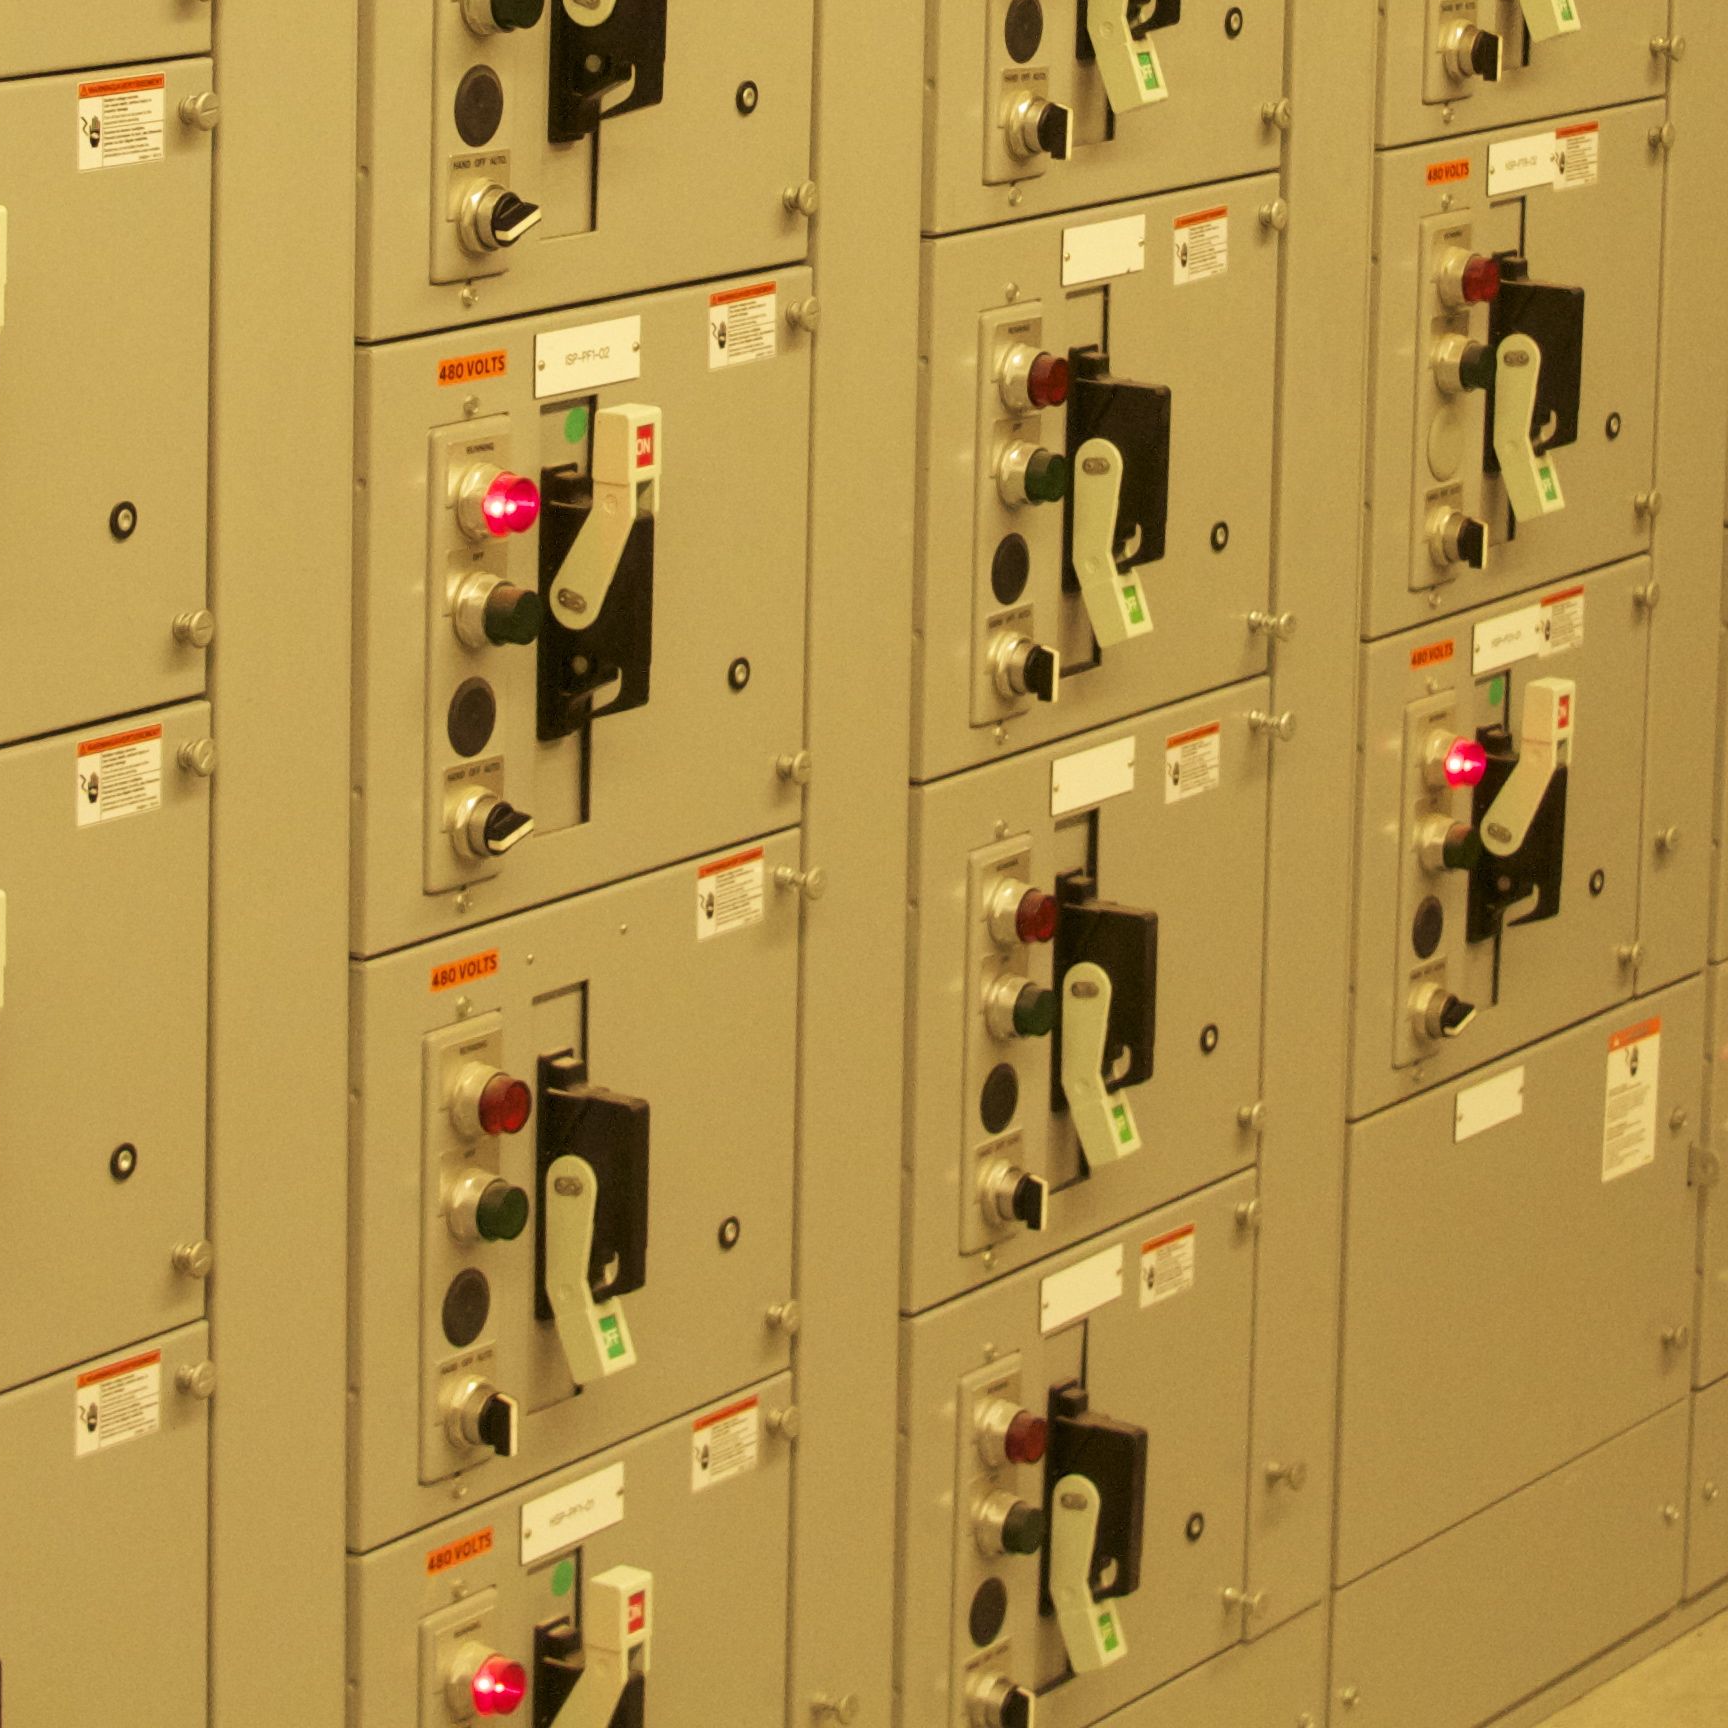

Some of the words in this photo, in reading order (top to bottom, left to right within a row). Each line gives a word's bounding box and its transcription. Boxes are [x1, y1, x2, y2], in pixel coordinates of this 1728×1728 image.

[439, 362, 463, 381] 480
[467, 355, 504, 376] VOLTS
[431, 967, 455, 988] 480
[459, 953, 496, 979] VOLTS
[428, 1549, 451, 1573] 480
[455, 1531, 492, 1561] VOLTS
